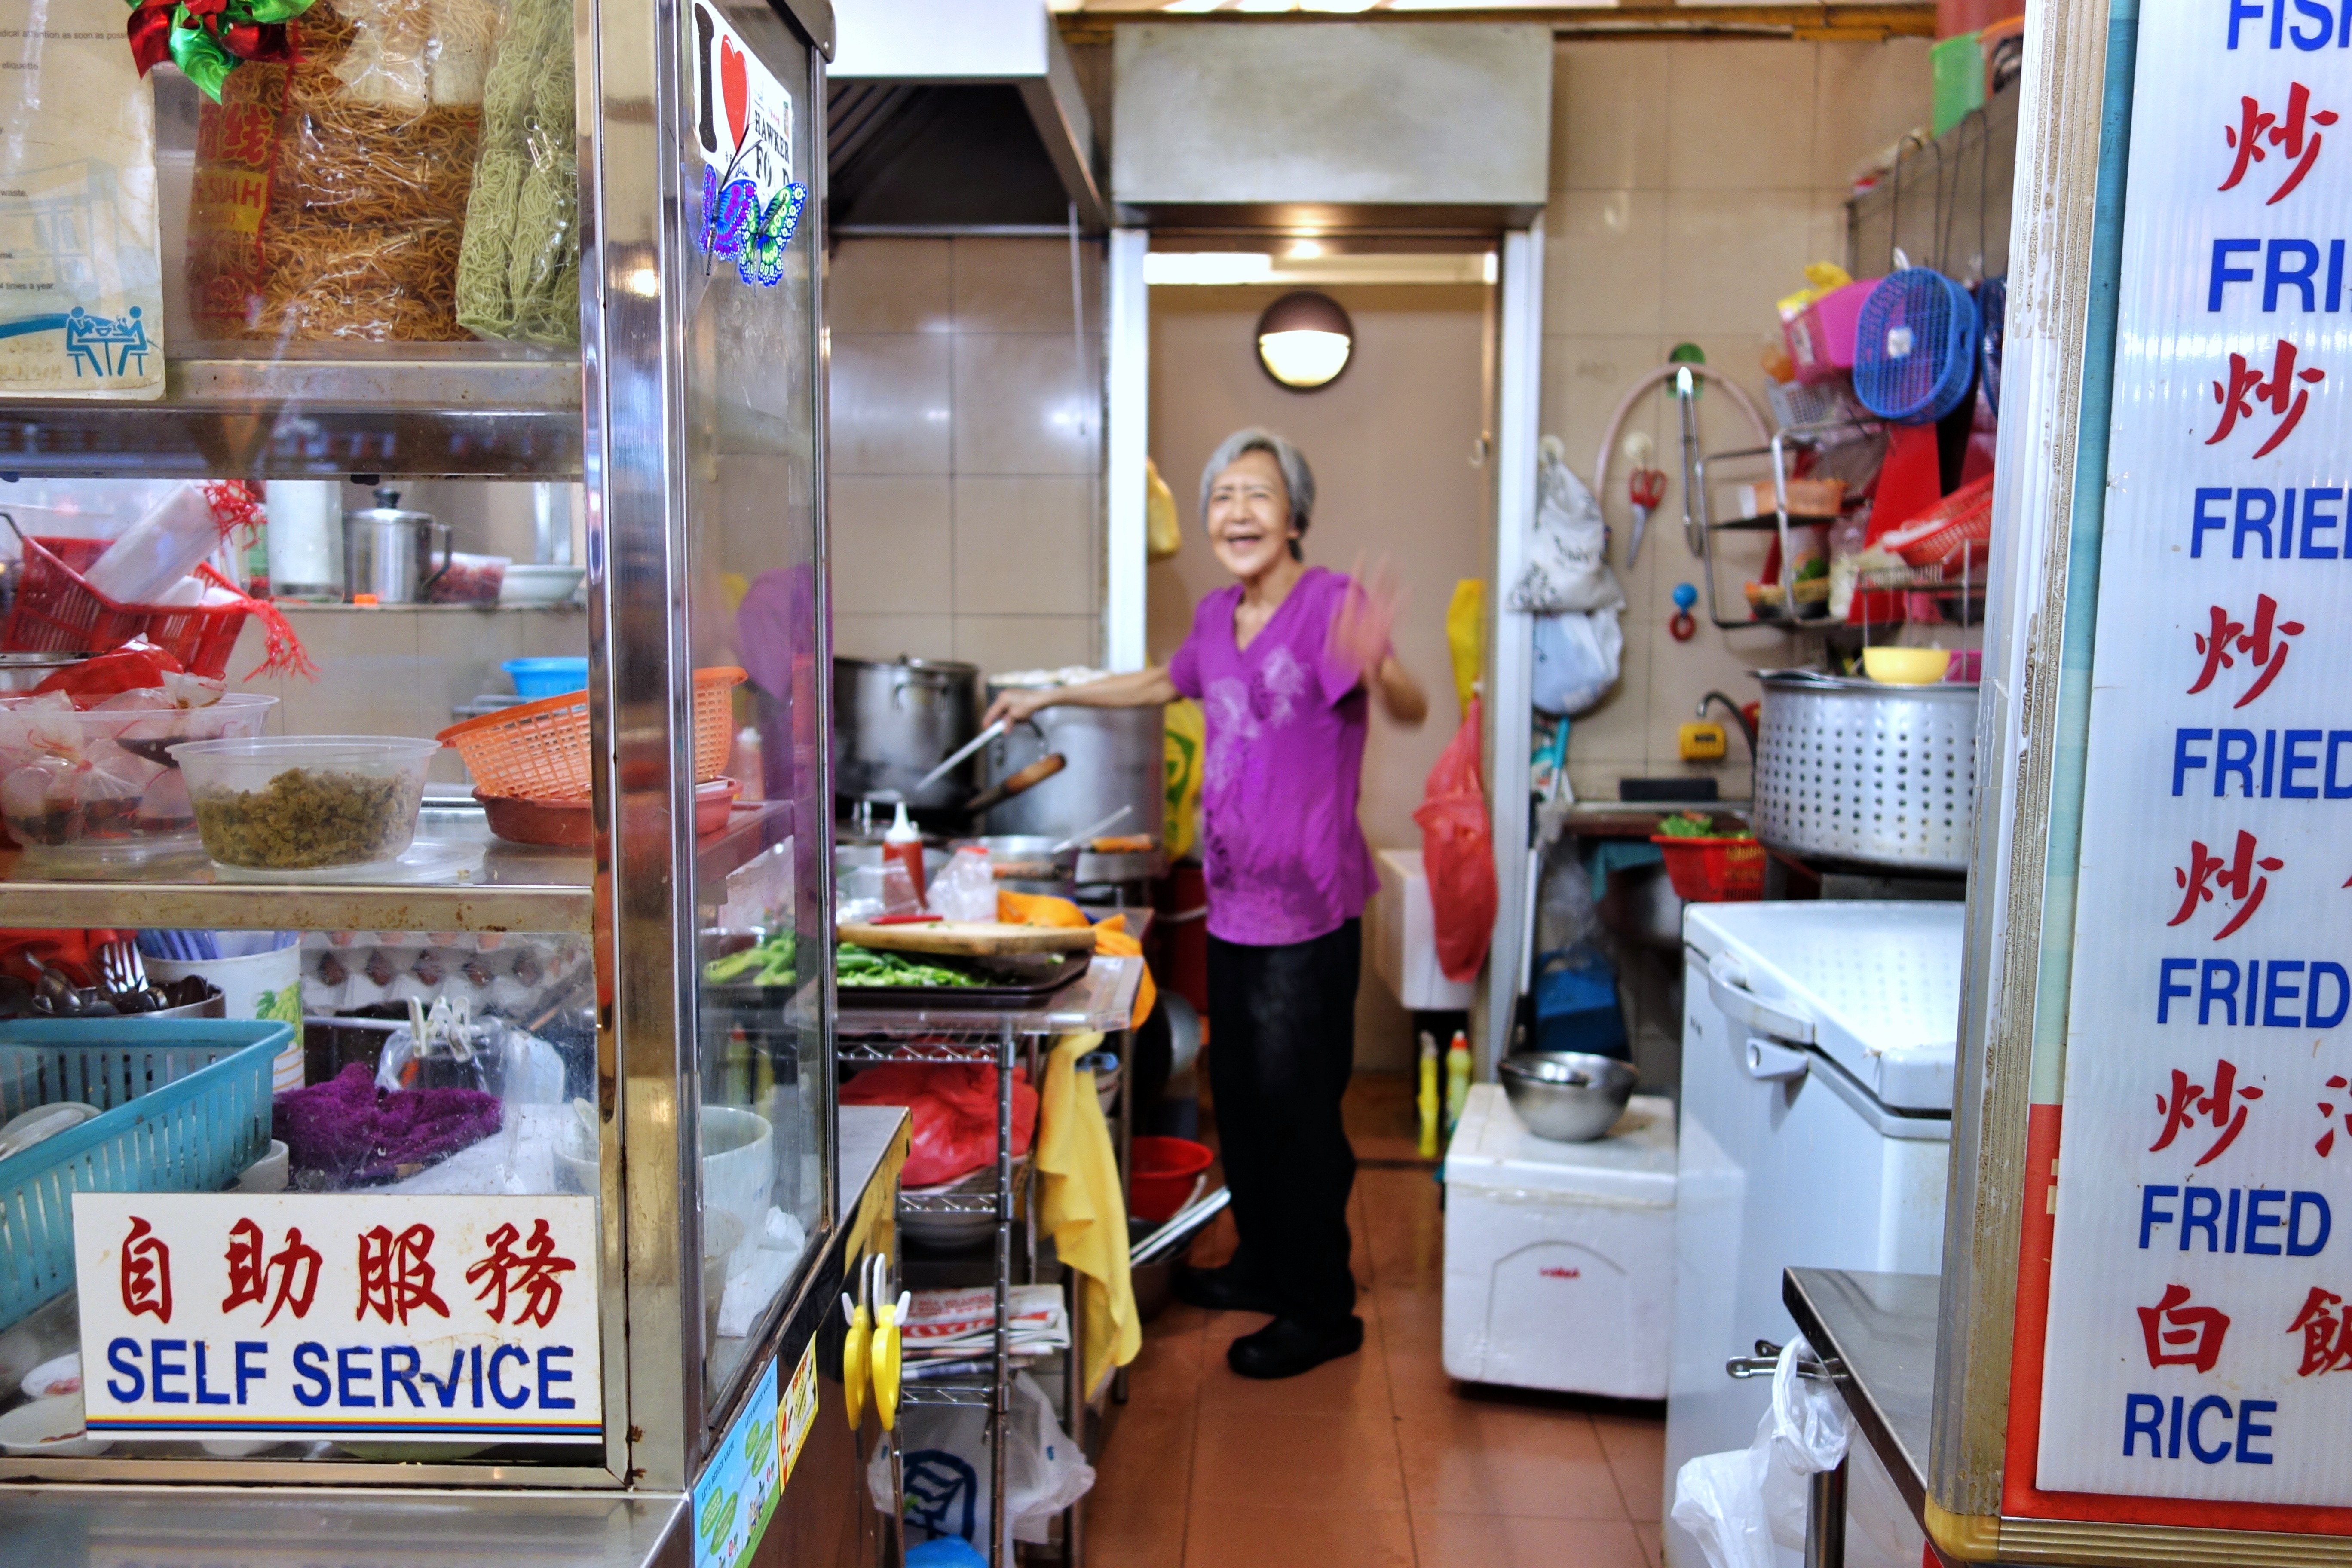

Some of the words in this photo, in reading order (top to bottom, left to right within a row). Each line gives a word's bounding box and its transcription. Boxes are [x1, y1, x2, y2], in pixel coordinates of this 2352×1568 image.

[695, 3, 717, 153] I
[755, 110, 789, 164] HAWKER
[2220, 82, 2338, 203] 炒
[2208, 239, 2352, 312] FRI
[2208, 340, 2324, 457] 炒
[2190, 488, 2352, 559] FRIE
[2190, 595, 2303, 707] 炒
[2170, 831, 2352, 940] 炒
[2157, 958, 2350, 1029] FRIED
[2139, 1185, 2331, 1256] FRIED
[121, 1216, 576, 1328] 自助服務
[108, 1338, 267, 1404] SELF
[294, 1343, 575, 1409] SERVICE
[2124, 1393, 2277, 1464] RICE
